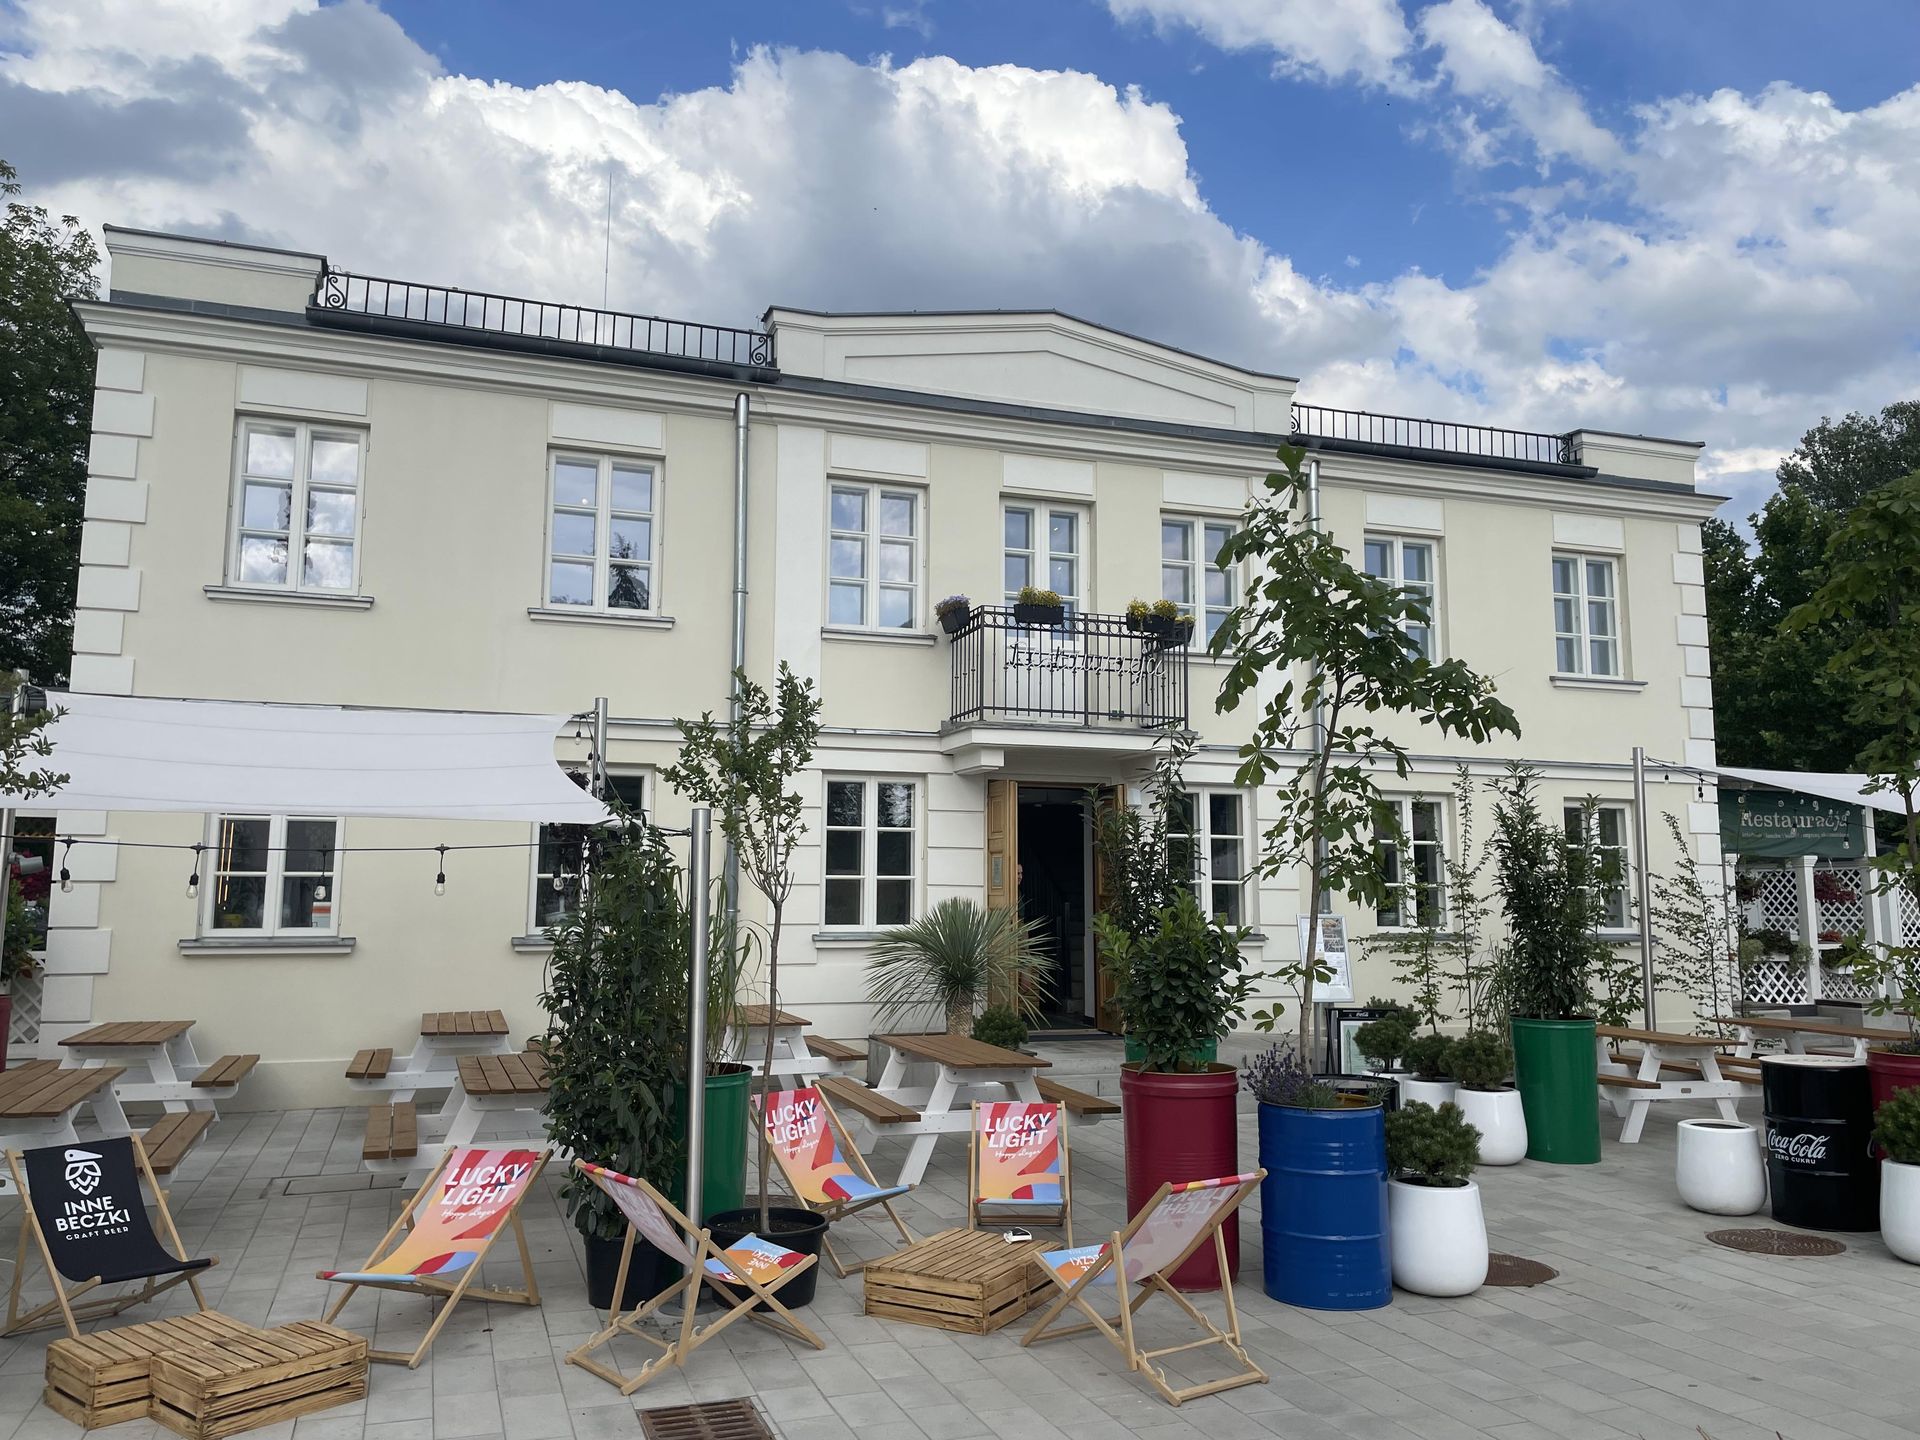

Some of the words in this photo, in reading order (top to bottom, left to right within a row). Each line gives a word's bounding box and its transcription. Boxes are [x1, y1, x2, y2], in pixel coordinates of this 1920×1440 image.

[1741, 810, 1848, 832] Restauracja
[765, 1097, 815, 1128] LUCKY
[985, 1111, 1052, 1133] LUCKY
[773, 1116, 817, 1145] LIGHT
[988, 1129, 1048, 1148] LIGHT
[1767, 1129, 1830, 1159] Coca-Cola
[1775, 1153, 1790, 1161] ZERO
[1790, 1156, 1816, 1165] CUKRU
[445, 1162, 529, 1186] LUCKY
[440, 1183, 516, 1205] LIGHT
[64, 1195, 115, 1216] INNE
[55, 1208, 131, 1232] BECZKI
[66, 1230, 99, 1240] CRAFT
[104, 1226, 129, 1235] BEER
